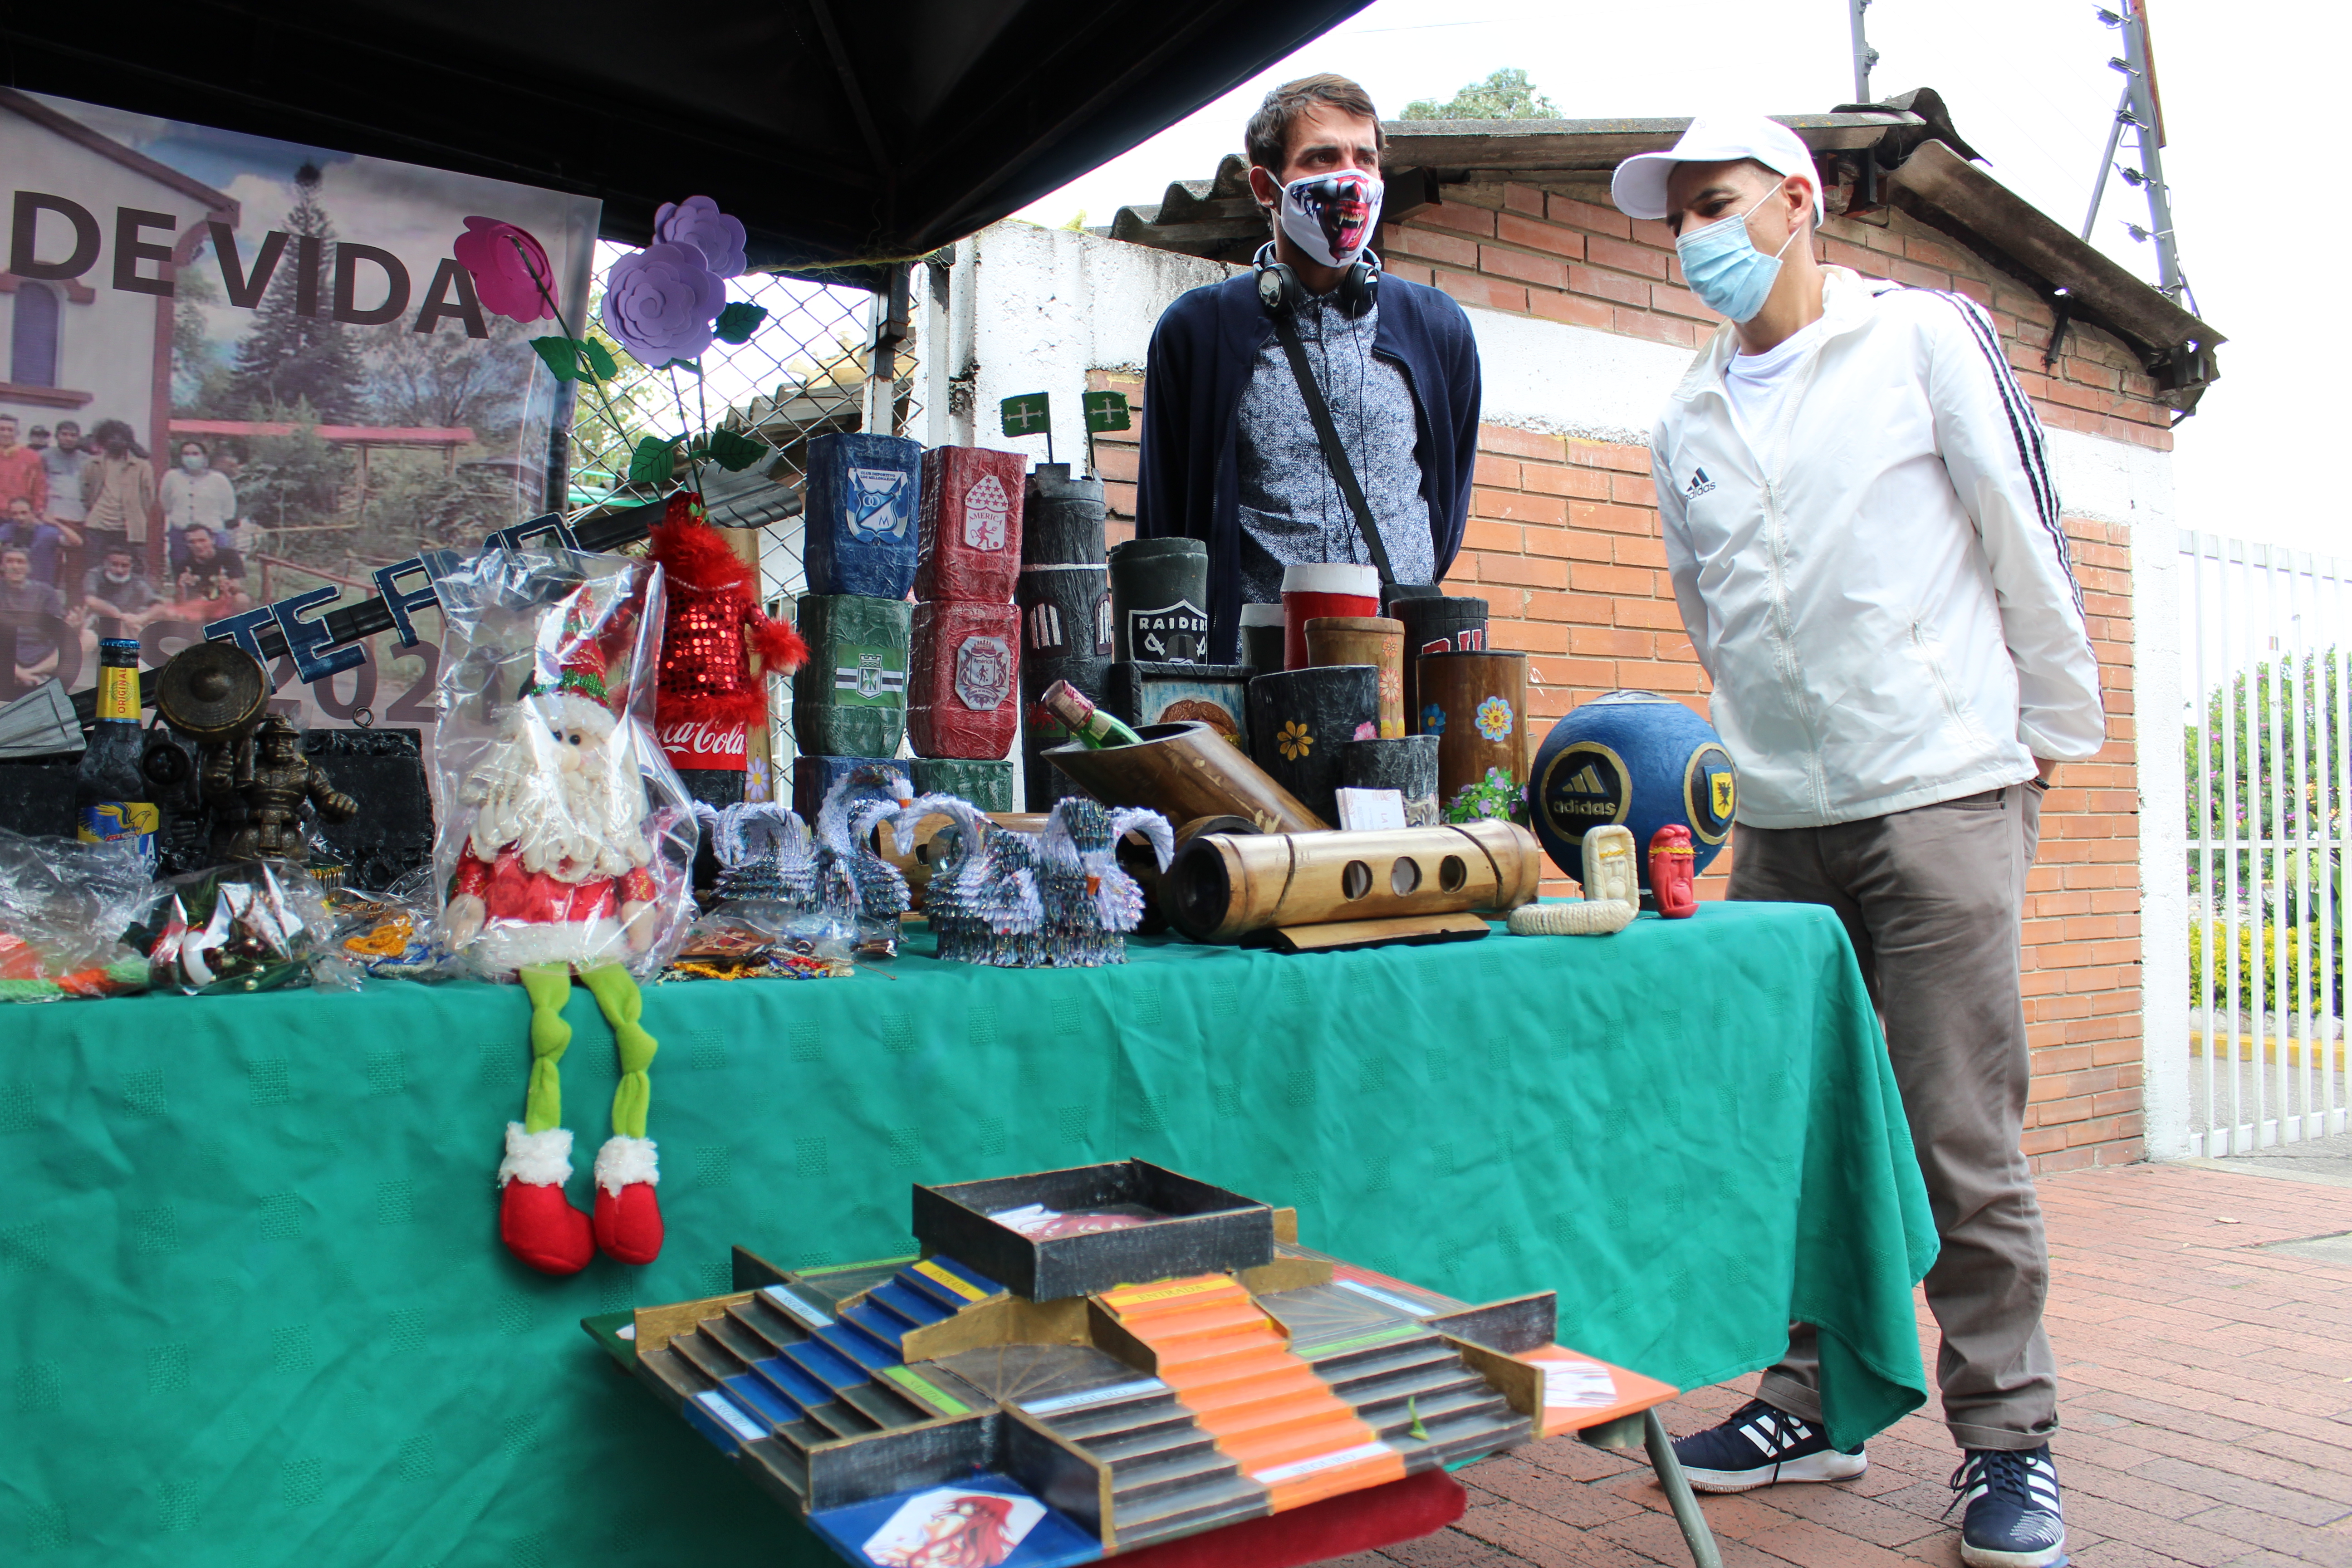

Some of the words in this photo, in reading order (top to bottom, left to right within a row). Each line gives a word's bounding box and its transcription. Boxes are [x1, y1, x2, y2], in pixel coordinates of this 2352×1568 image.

[10, 190, 176, 298] DE
[207, 220, 490, 340] VIDA
[969, 512, 1003, 526] AMERICA
[118, 668, 127, 714] ORIGINAL
[1553, 799, 1616, 816] adidas
[930, 1270, 969, 1293] ENTRADA
[1137, 1284, 1205, 1301] ENTRADA
[784, 1296, 814, 1316] SEGURO
[1059, 1389, 1128, 1407] SEGURO
[716, 1404, 749, 1427] SEGURO
[1292, 1454, 1356, 1474] SEGURO
